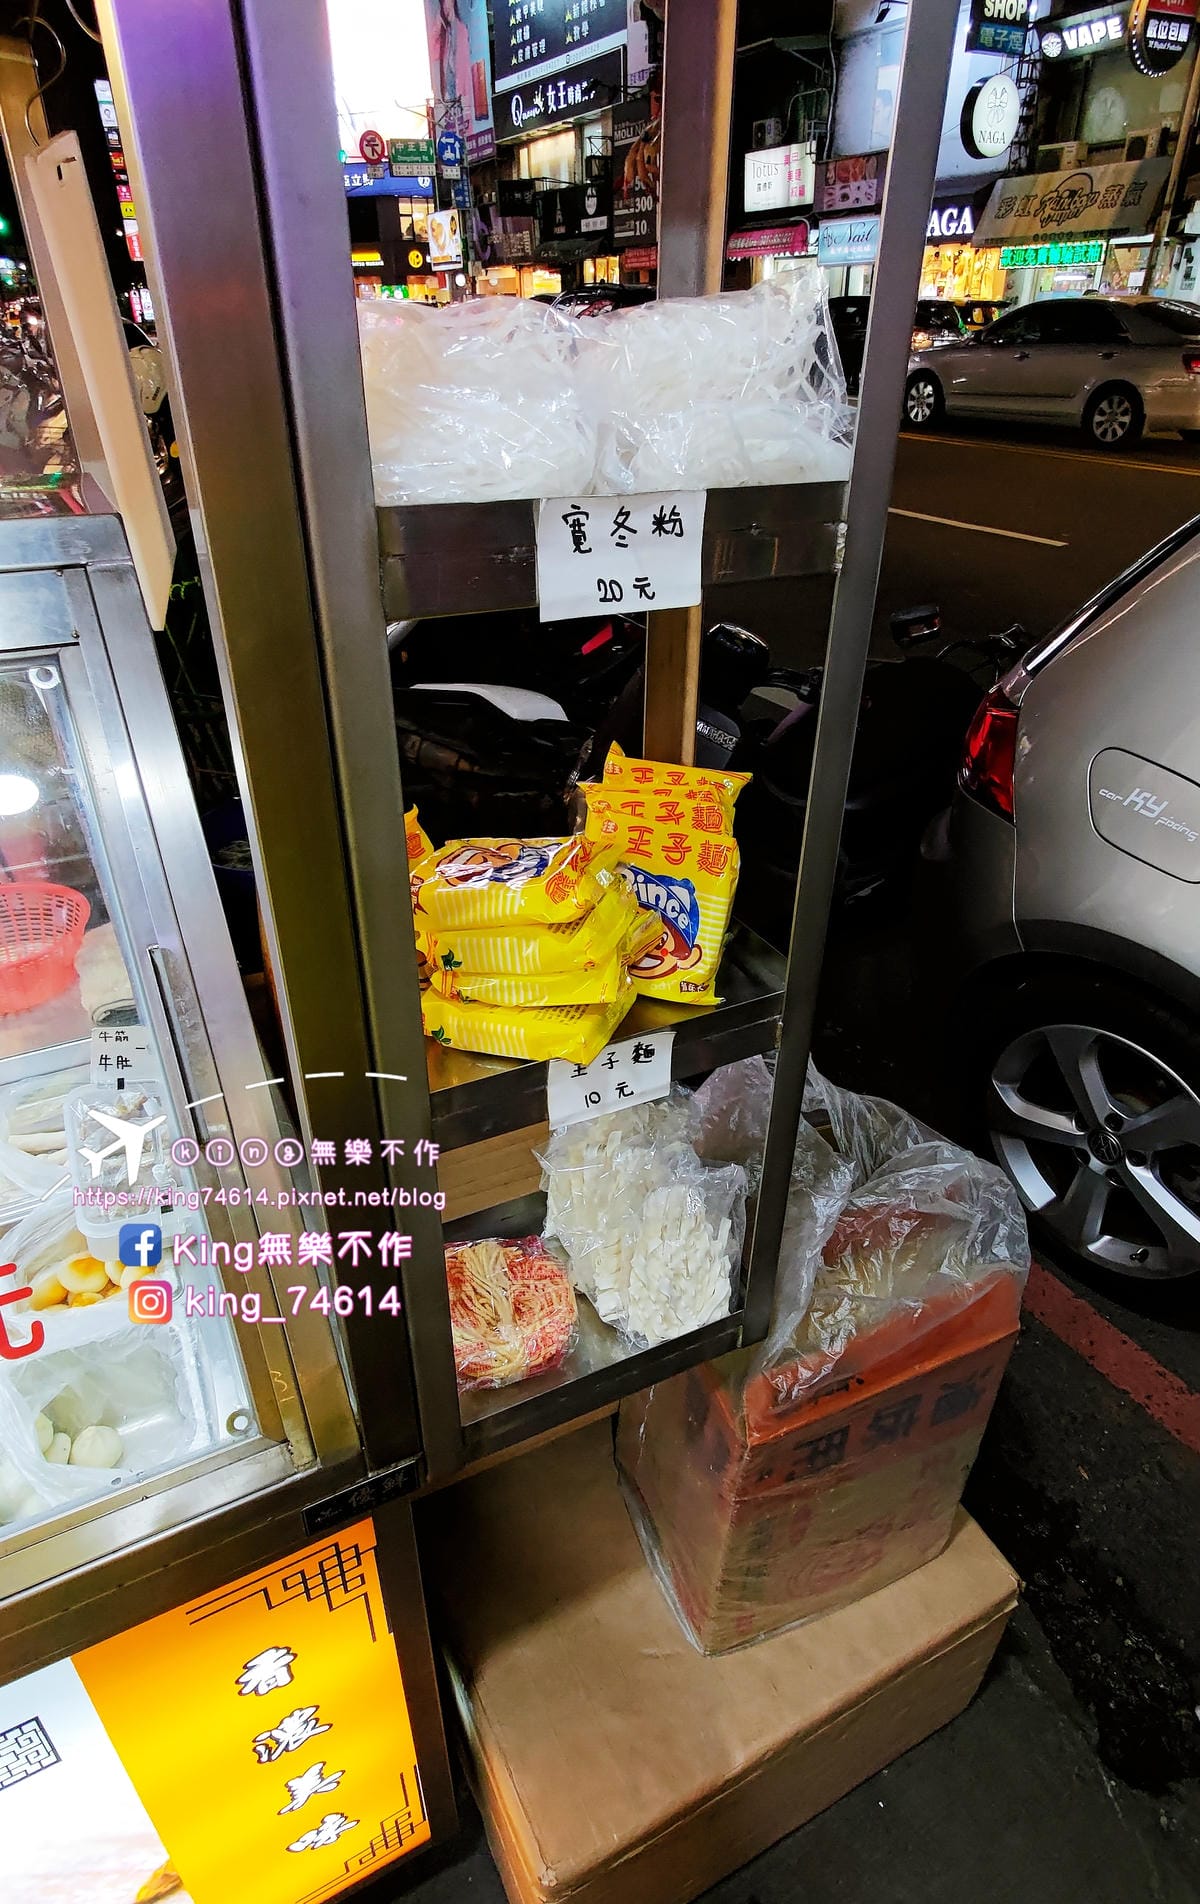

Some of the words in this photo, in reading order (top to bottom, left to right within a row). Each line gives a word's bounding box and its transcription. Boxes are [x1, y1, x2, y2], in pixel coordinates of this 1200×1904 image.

[984, 0, 1027, 21] SHOP
[981, 27, 1024, 50] 電子煙
[1062, 16, 1123, 50] VAPE
[978, 130, 1006, 144] NAGA
[752, 162, 779, 179] lotus
[846, 221, 878, 243] Nail
[561, 504, 684, 554] 寬冬粉
[597, 577, 656, 602] 20元
[1099, 788, 1123, 801] car
[625, 825, 731, 877] 王子麵
[98, 1054, 133, 1072] 牛肚
[571, 1042, 656, 1078] 王子麵
[584, 1081, 635, 1108] 10元
